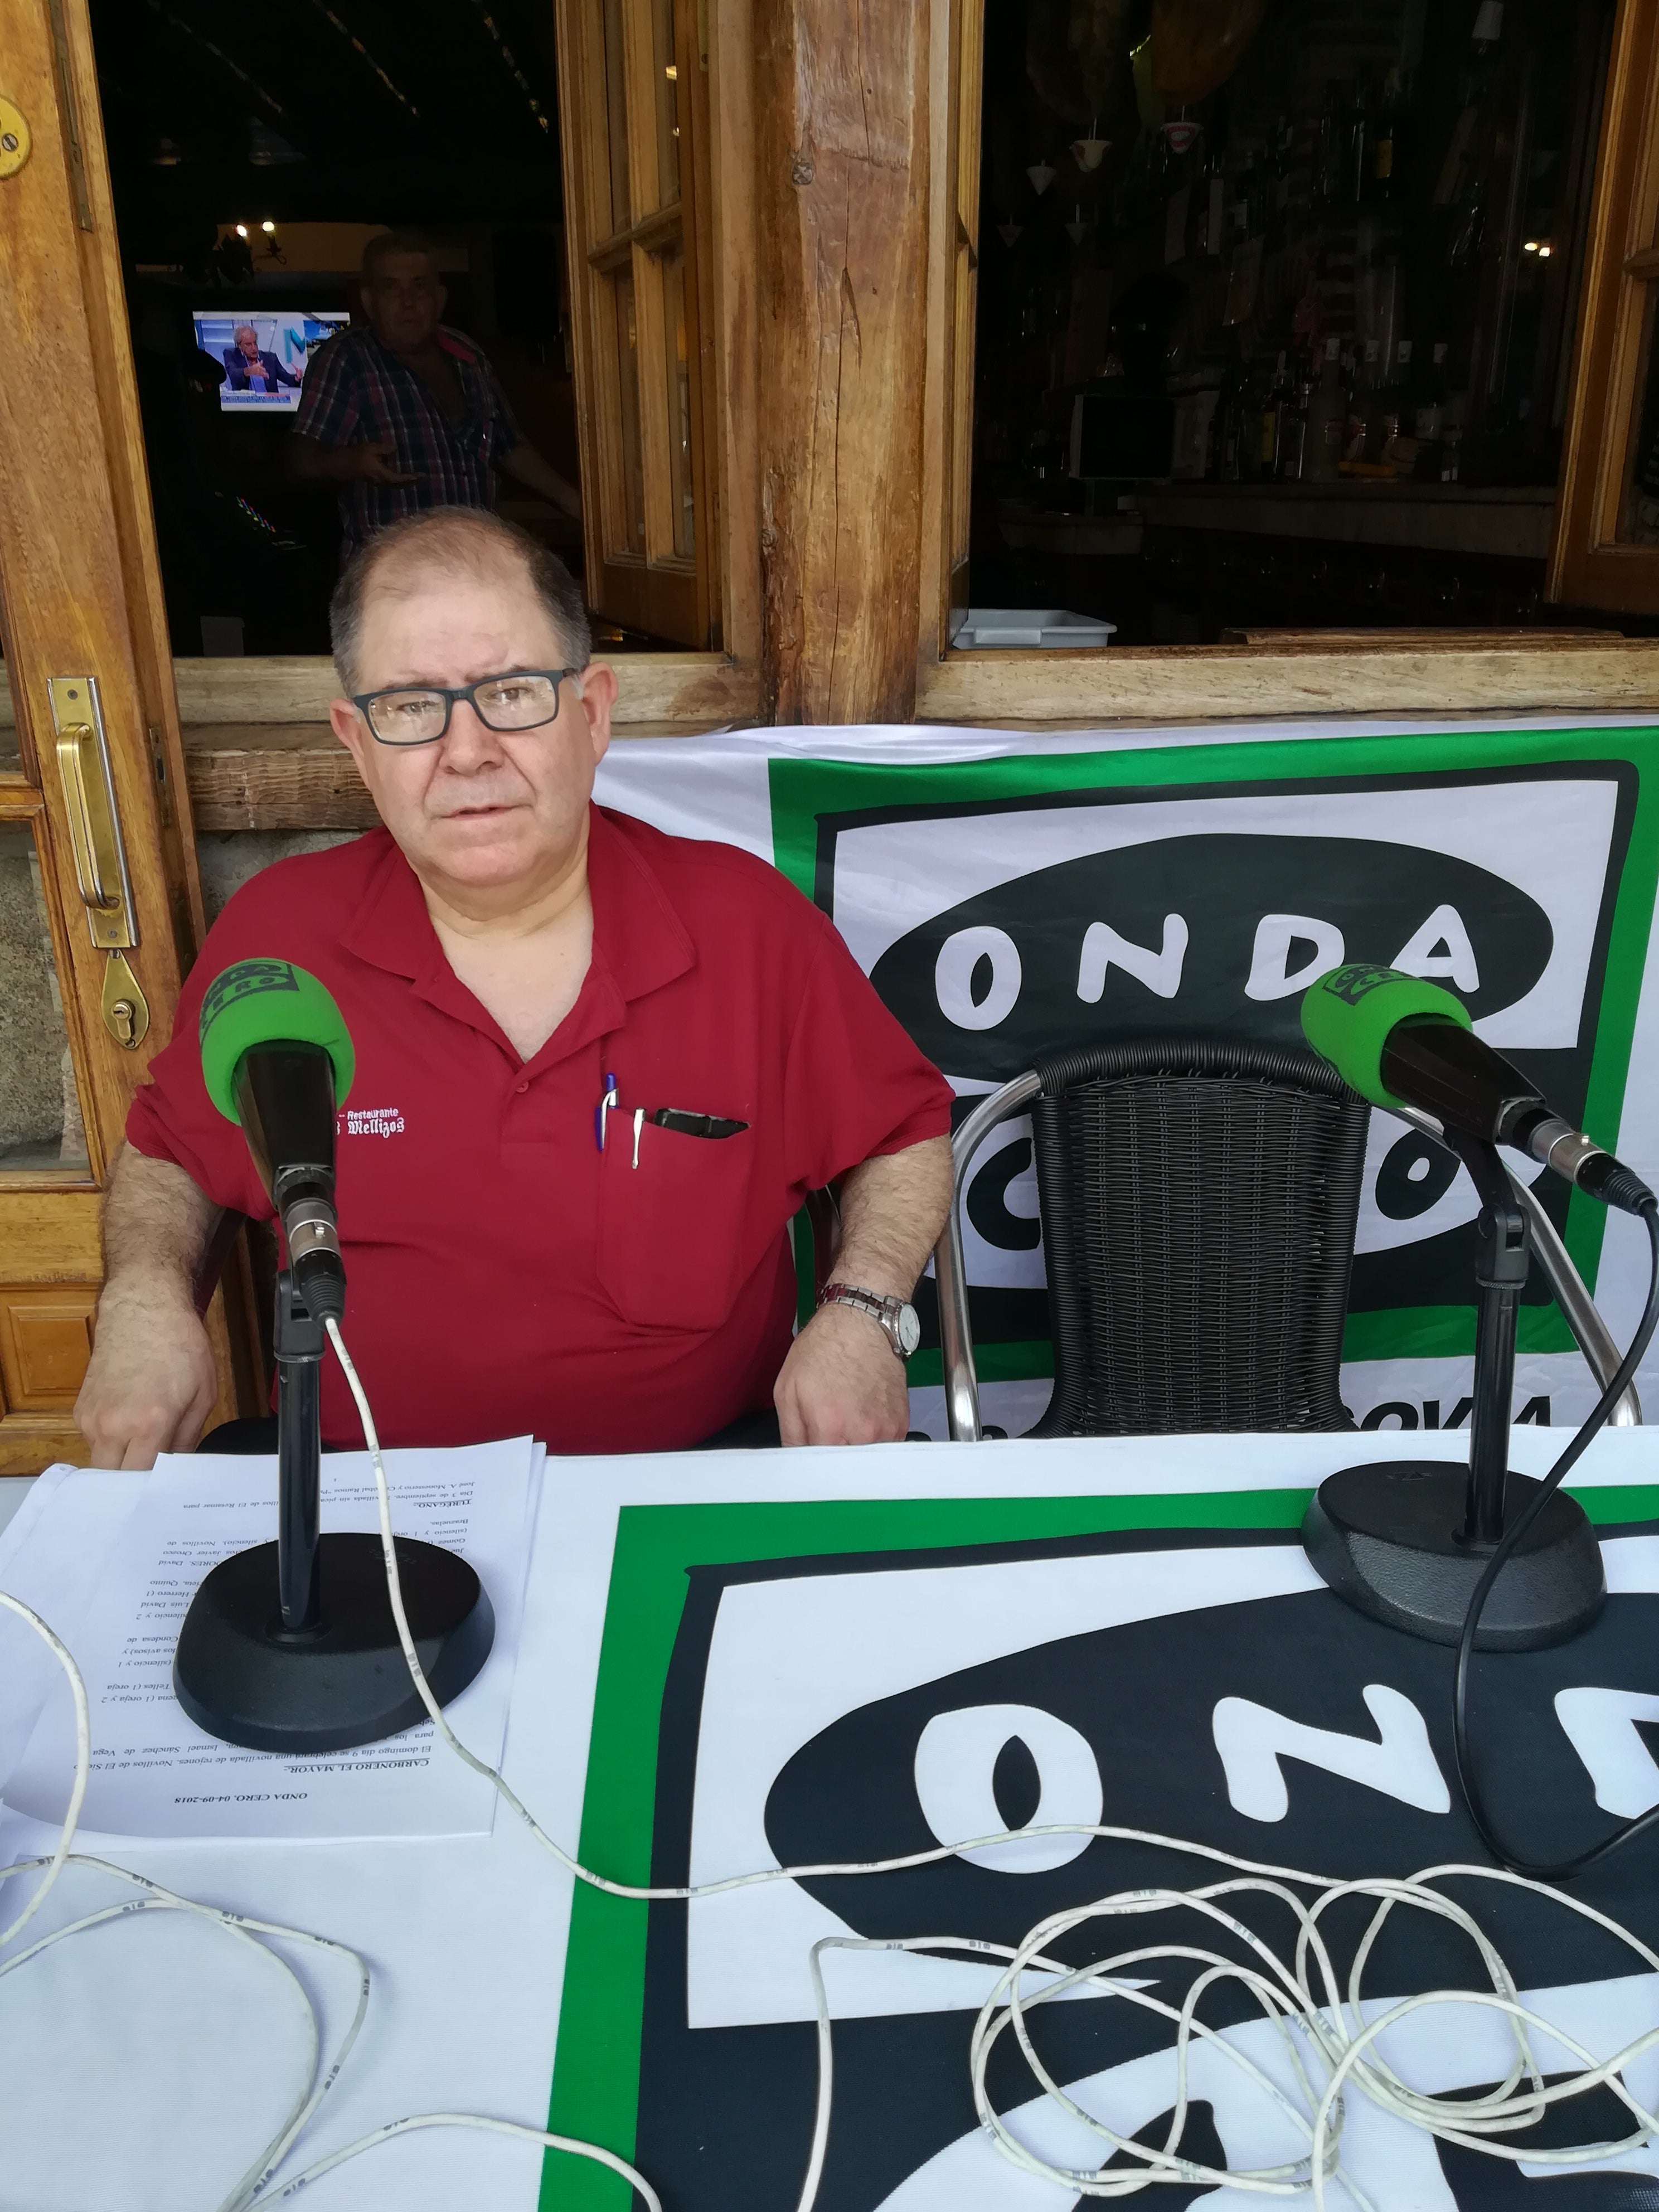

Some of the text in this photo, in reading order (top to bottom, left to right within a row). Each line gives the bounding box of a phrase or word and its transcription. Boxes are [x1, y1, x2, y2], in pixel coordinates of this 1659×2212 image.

[934, 904, 1479, 1030] ONDA
[347, 1107, 399, 1120] Restaurante
[119, 1695, 142, 1703] oreja
[414, 1730, 434, 1739] para
[93, 1748, 115, 1757] Vega
[142, 1746, 181, 1755] Sánchez
[187, 1744, 219, 1753] Ismael
[379, 1747, 418, 1757] domingo
[230, 1754, 273, 1763] novillada
[133, 1760, 173, 1768] Novillos
[336, 1763, 352, 1772] EL
[355, 1759, 430, 1771] CARBONERO
[174, 1796, 230, 1804] 04-09-2018
